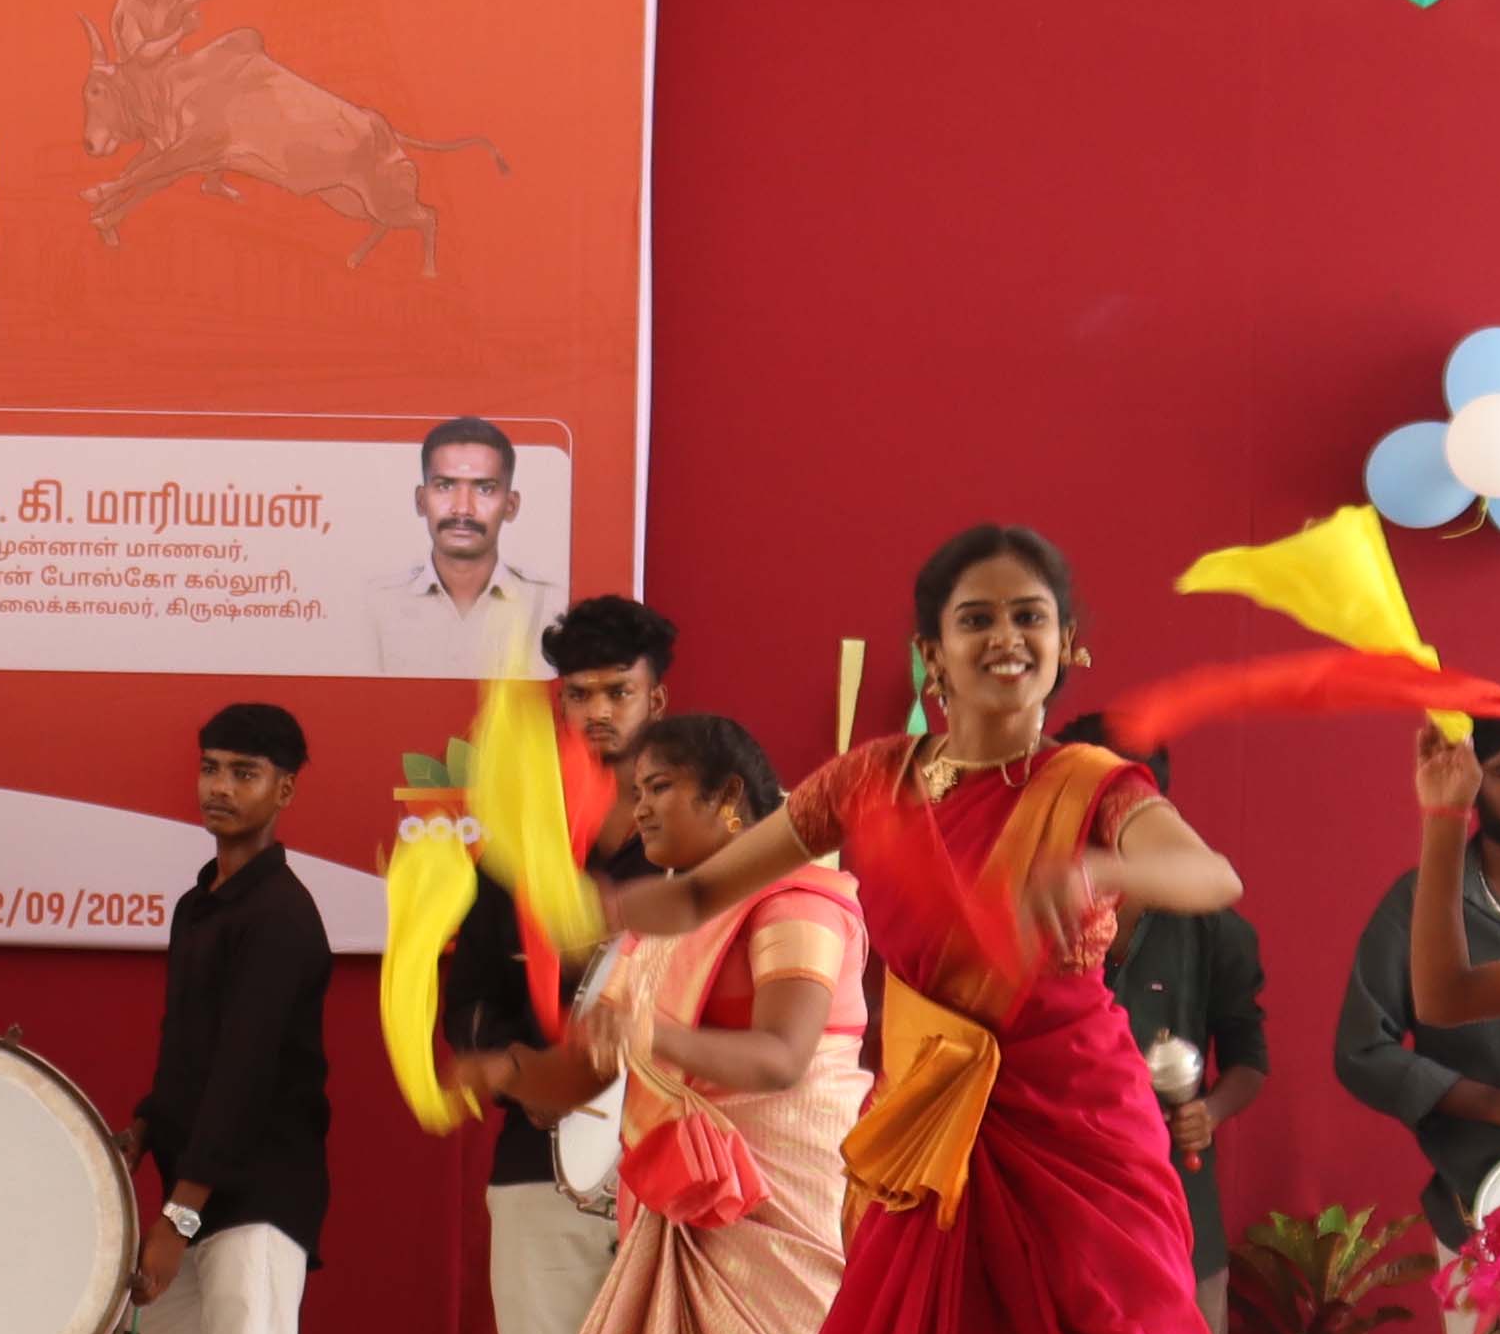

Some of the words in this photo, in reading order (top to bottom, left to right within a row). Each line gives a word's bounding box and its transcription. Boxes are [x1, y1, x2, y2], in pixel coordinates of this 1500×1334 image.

[18, 479, 74, 524] கி.
[87, 481, 331, 534] மாரியப்பன்,
[126, 537, 249, 563] மாணவர்,
[41, 565, 177, 589] போஸ்கோ
